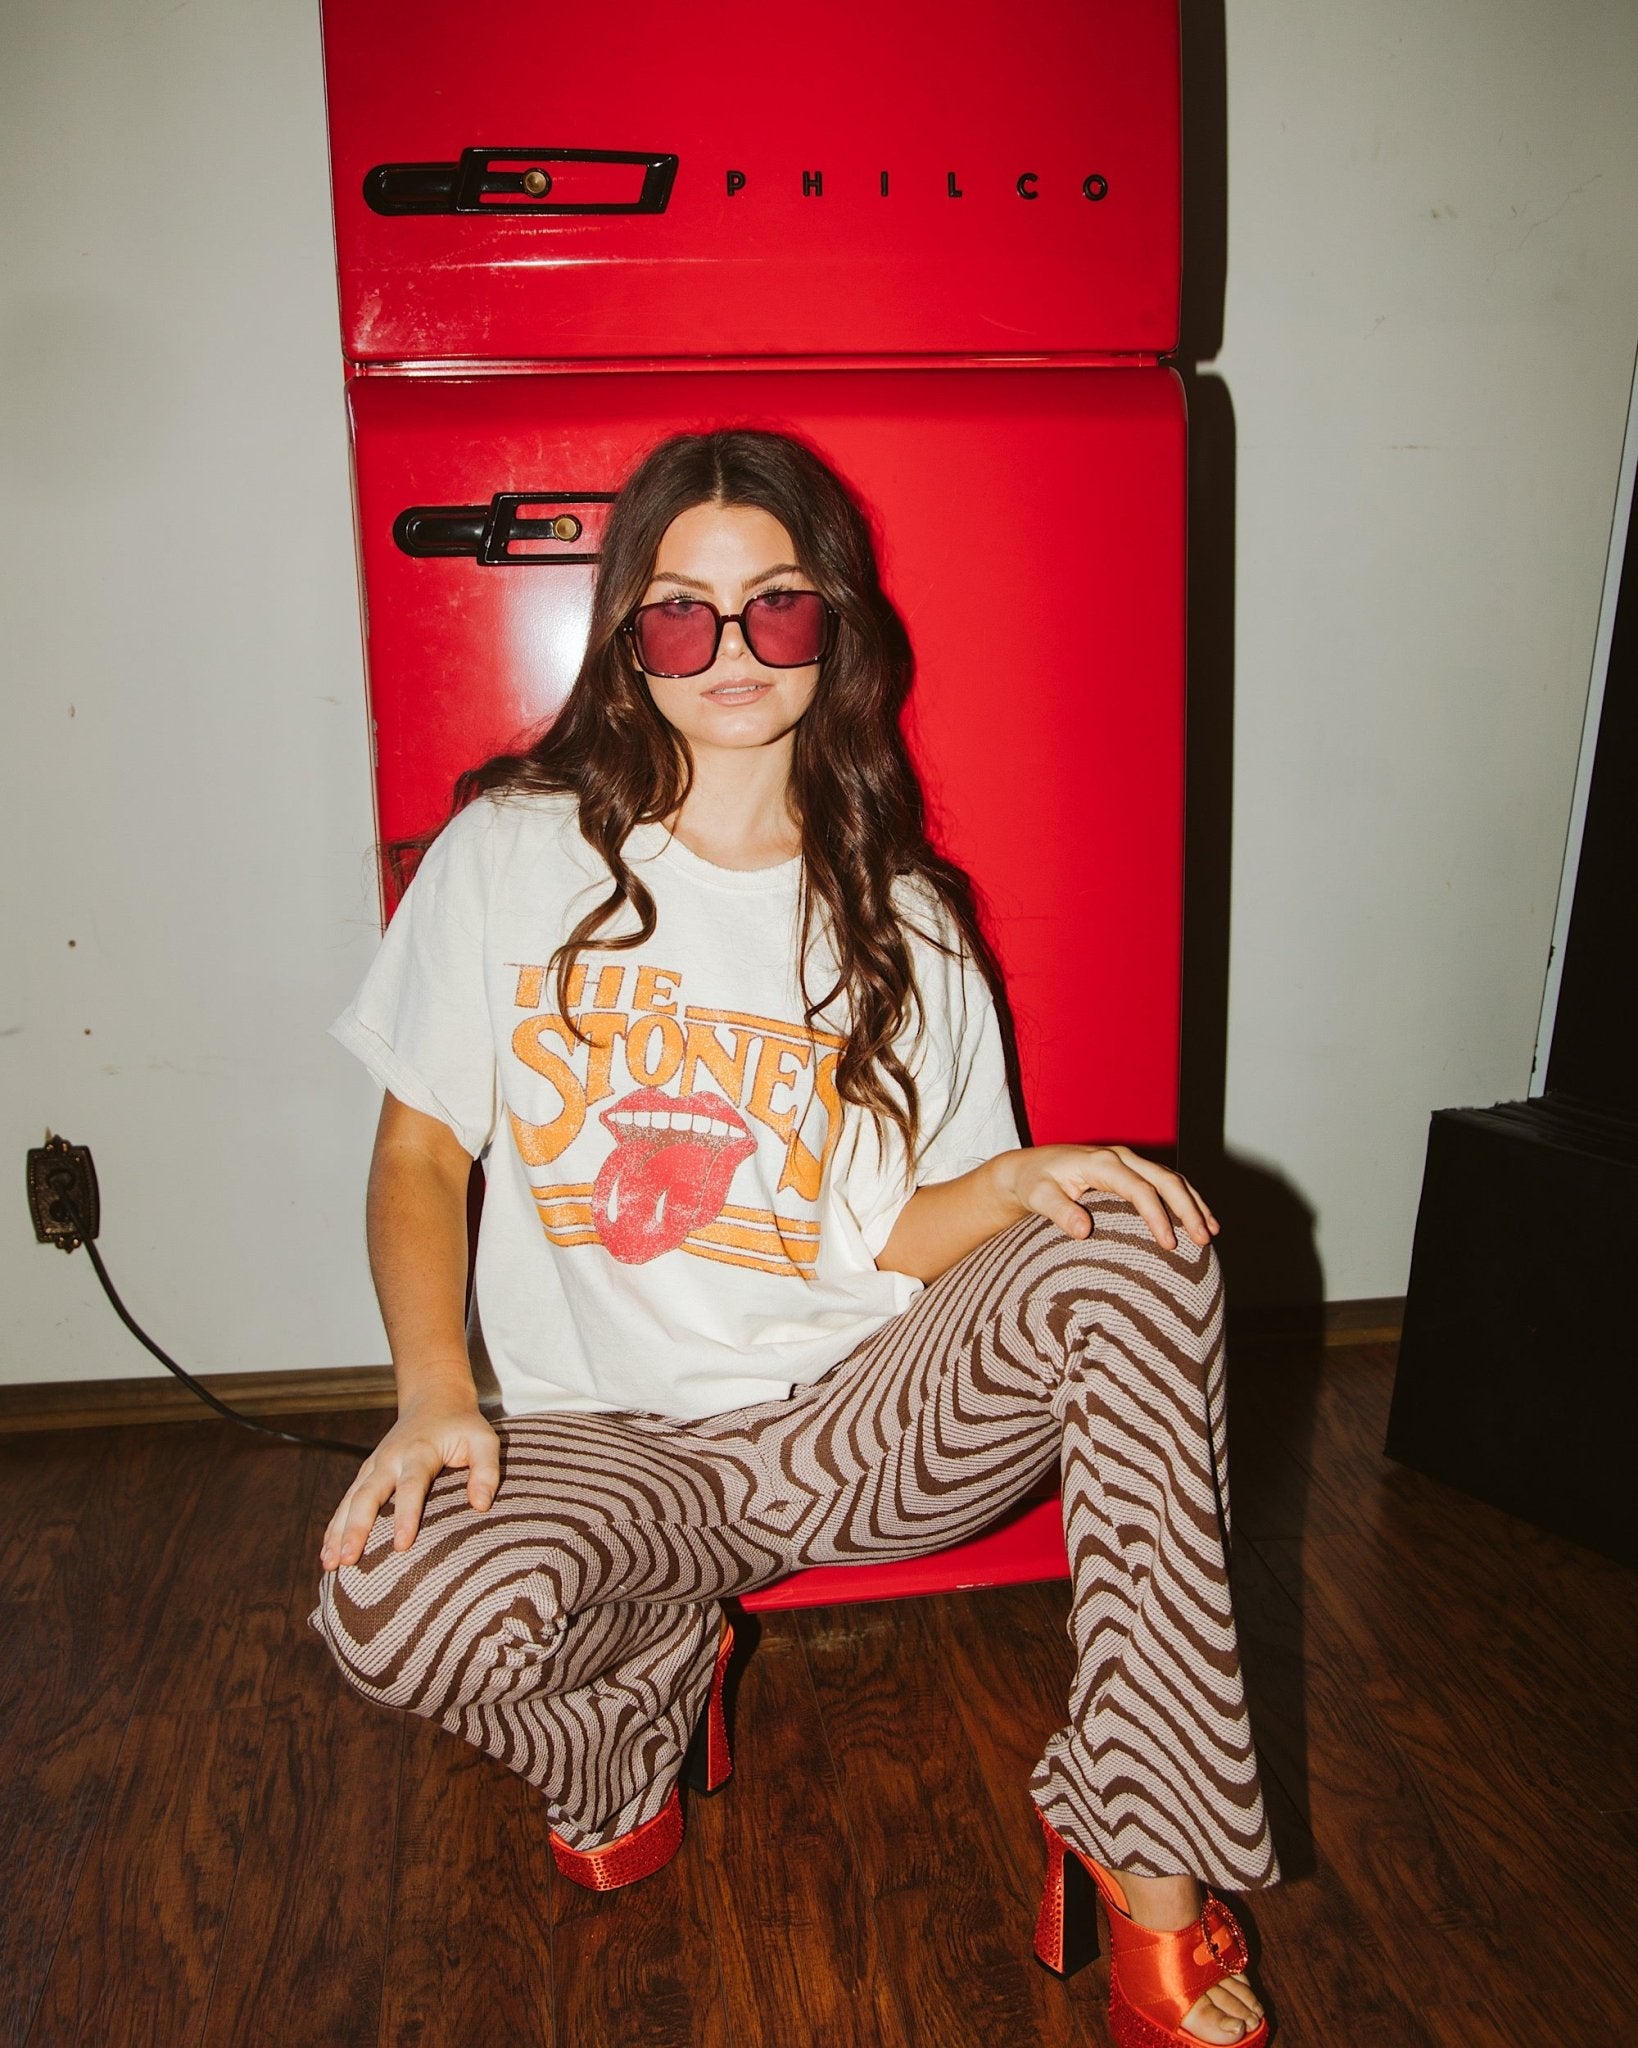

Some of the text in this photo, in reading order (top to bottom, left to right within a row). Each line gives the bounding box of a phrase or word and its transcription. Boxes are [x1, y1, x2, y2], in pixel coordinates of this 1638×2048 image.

[726, 170, 1109, 202] PHILCO
[504, 963, 682, 1015] THE
[509, 1011, 847, 1202] STONES
